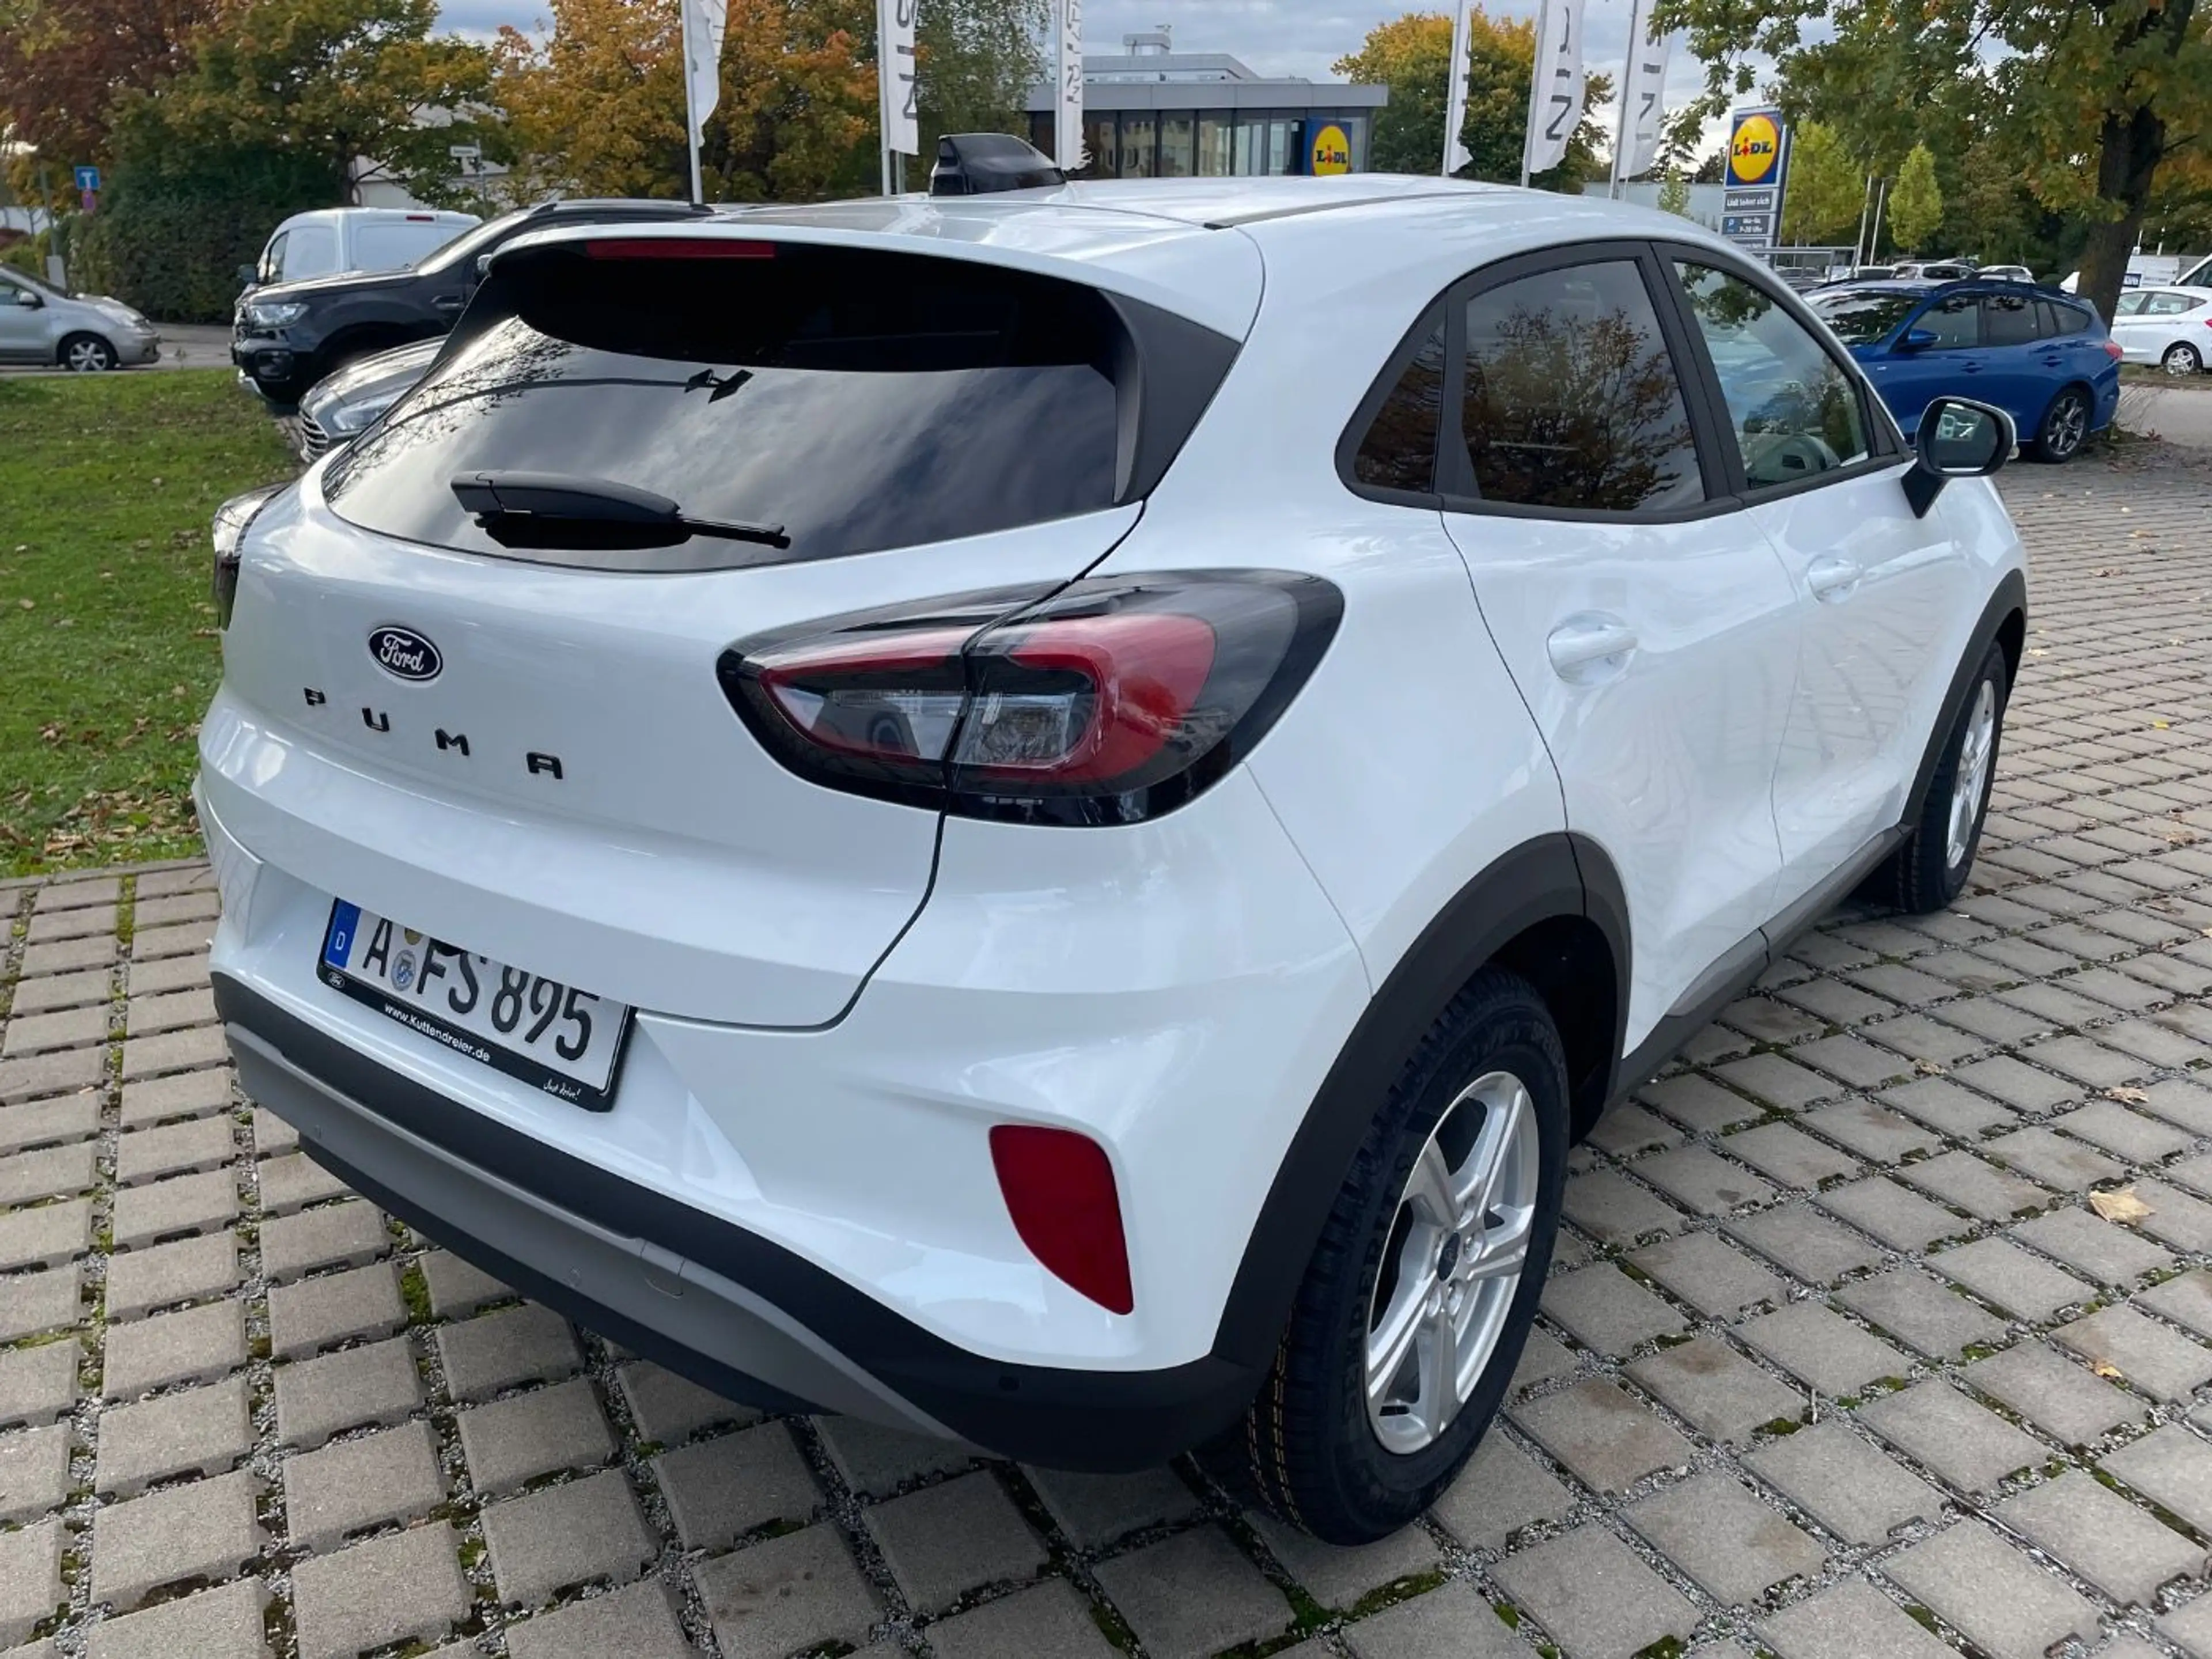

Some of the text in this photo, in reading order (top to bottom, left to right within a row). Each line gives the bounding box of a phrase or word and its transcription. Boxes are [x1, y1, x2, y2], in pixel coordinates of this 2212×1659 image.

[380, 633, 425, 672] Ford
[303, 687, 563, 780] PUMA
[335, 930, 346, 950] D
[363, 918, 392, 977] A
[384, 1002, 491, 1062] www.Kuttendreier.de
